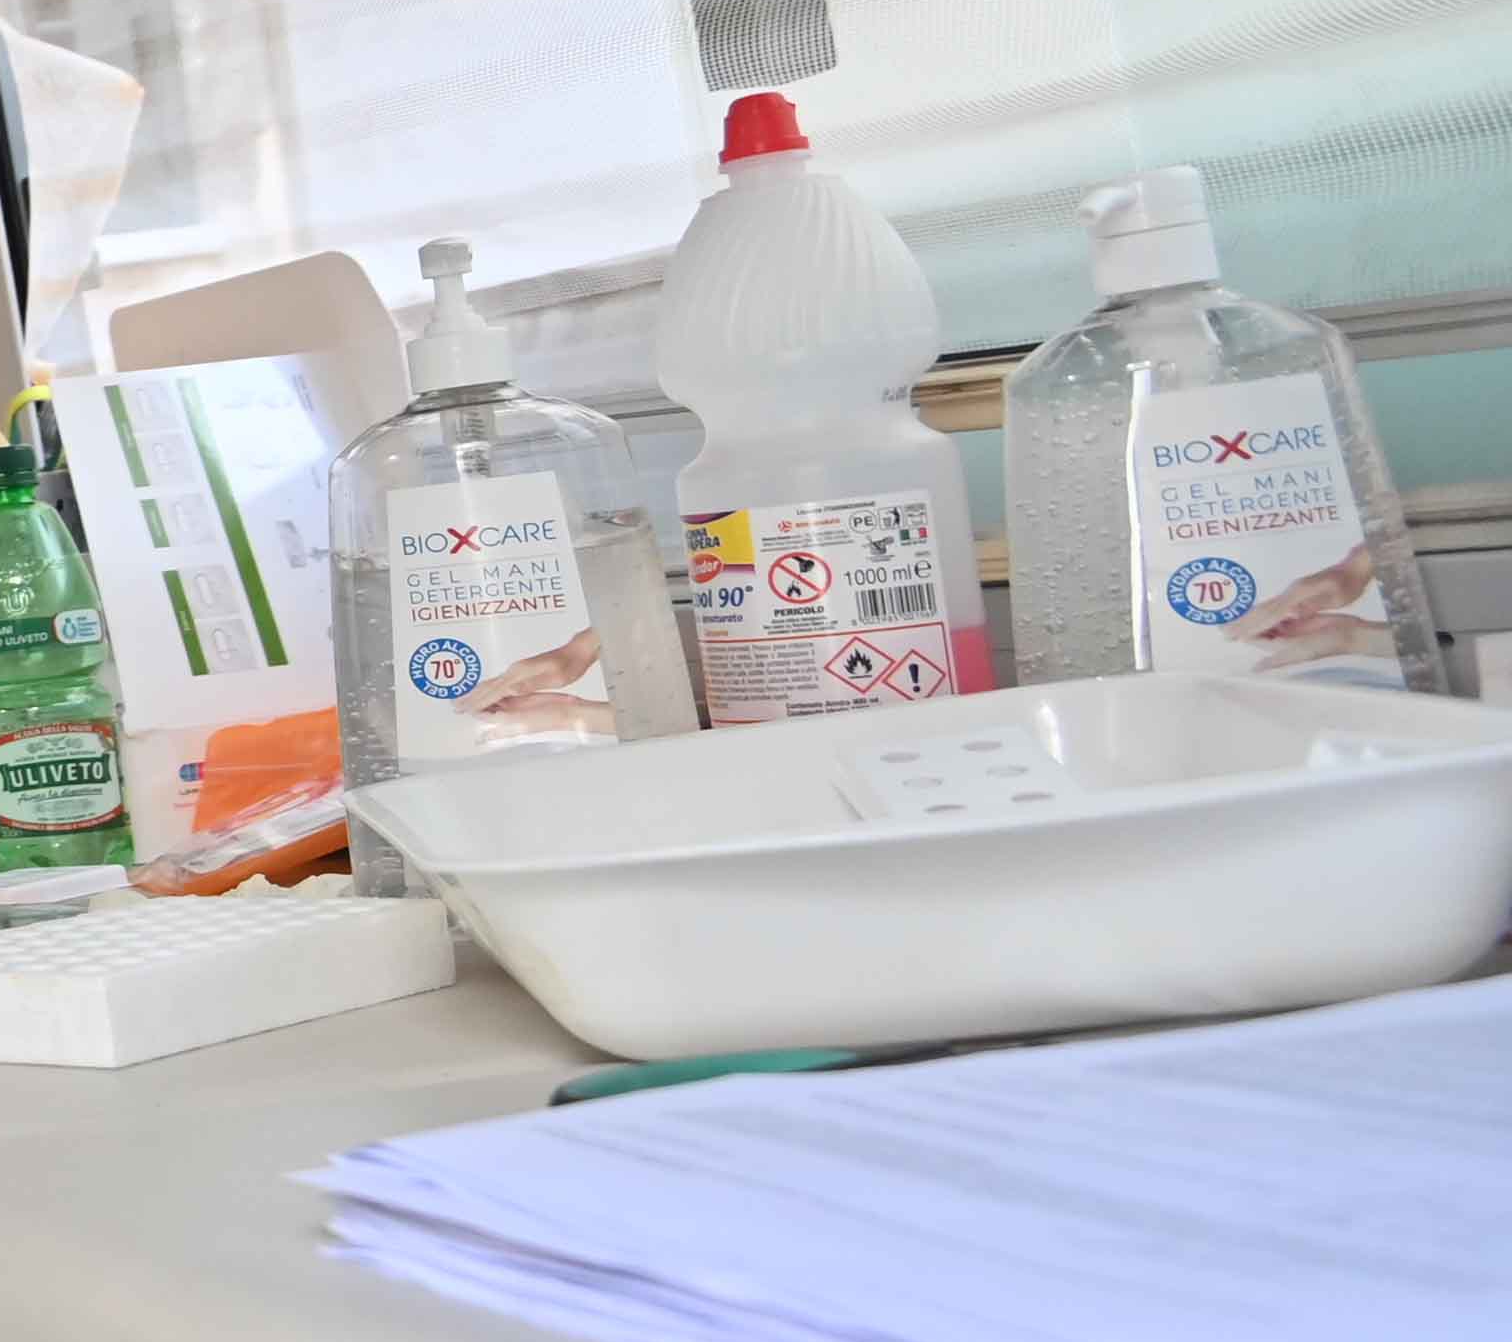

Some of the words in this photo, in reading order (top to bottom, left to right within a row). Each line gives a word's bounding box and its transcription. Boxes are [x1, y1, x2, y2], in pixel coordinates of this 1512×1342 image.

[1153, 424, 1326, 468] BIOXCARE
[1161, 483, 1229, 502] GEL
[1254, 467, 1333, 491] MANI
[1164, 485, 1337, 522] DETERGENTE
[853, 516, 874, 527] PE
[1168, 505, 1340, 541] IGIENIZZANTE
[401, 519, 558, 556] BIOXCARE
[406, 569, 462, 588] GEL
[483, 558, 561, 579] MANI
[844, 568, 887, 587] 1000
[1168, 561, 1205, 602] HYDRO
[409, 575, 564, 605] DETERGENTE
[718, 585, 754, 608] 90°
[1194, 579, 1232, 603] 70°
[1207, 560, 1256, 622] ALCOHOLIC
[411, 593, 566, 622] IGIENIZZANTE
[774, 606, 824, 617] PERICOLO
[1183, 605, 1218, 624] GEL
[5, 632, 48, 646] ULIVETO
[411, 641, 440, 681] HYDRO
[430, 658, 461, 680] 70°
[440, 640, 481, 696] ALCOHOLIC
[423, 683, 449, 698] GEL
[10, 762, 104, 788] ULIVETO
